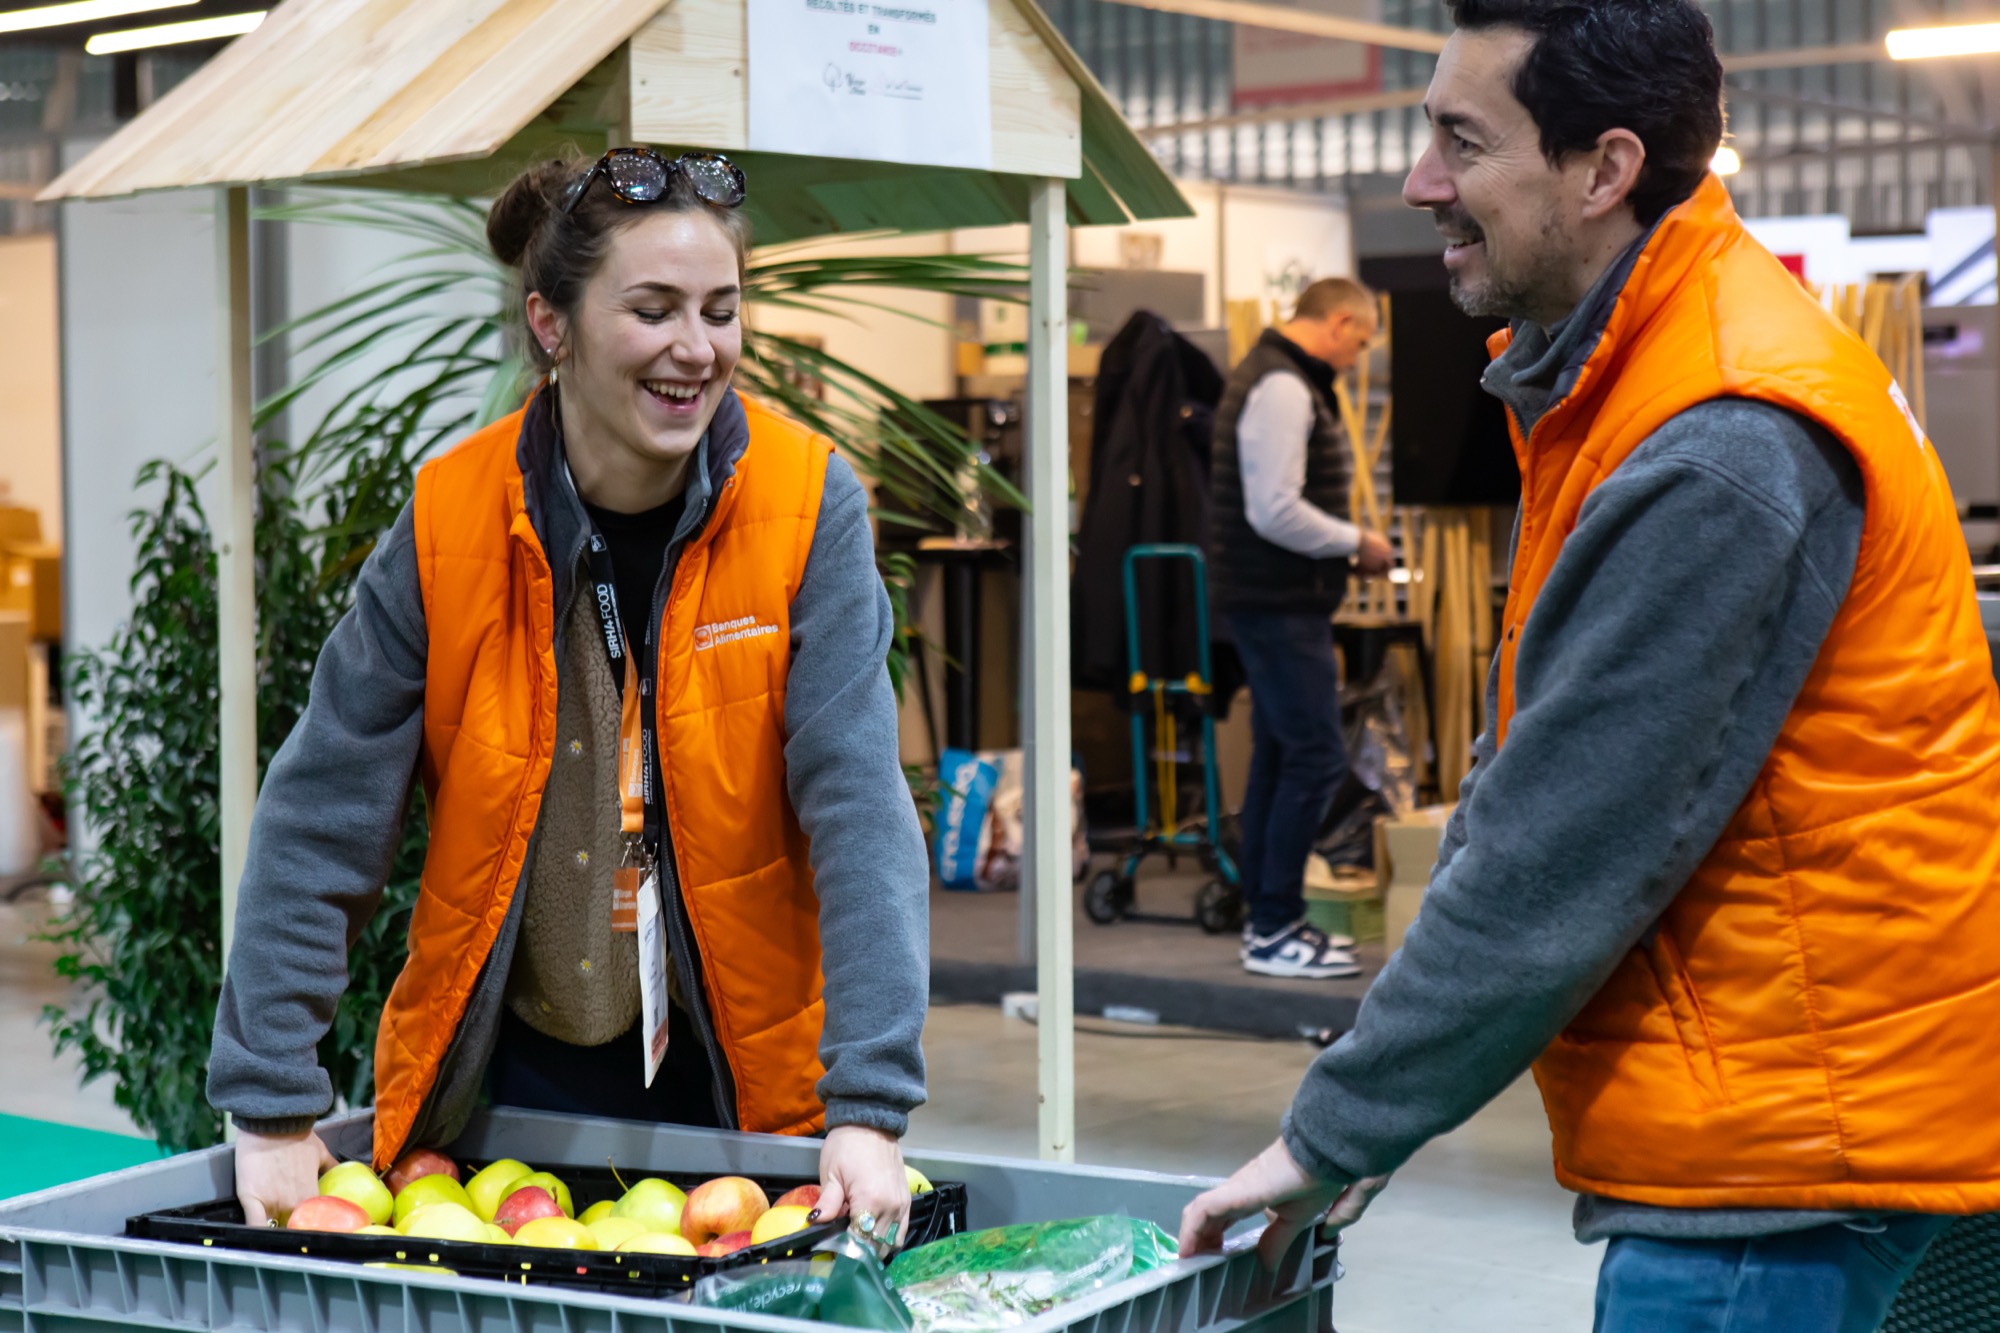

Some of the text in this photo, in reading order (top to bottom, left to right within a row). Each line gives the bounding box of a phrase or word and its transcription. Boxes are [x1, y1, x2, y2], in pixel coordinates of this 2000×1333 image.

[858, 4, 870, 14] ET
[868, 24, 880, 34] EN
[711, 615, 756, 634] Banques
[714, 624, 779, 646] Alimentaires
[748, 1281, 802, 1311] recycle,
